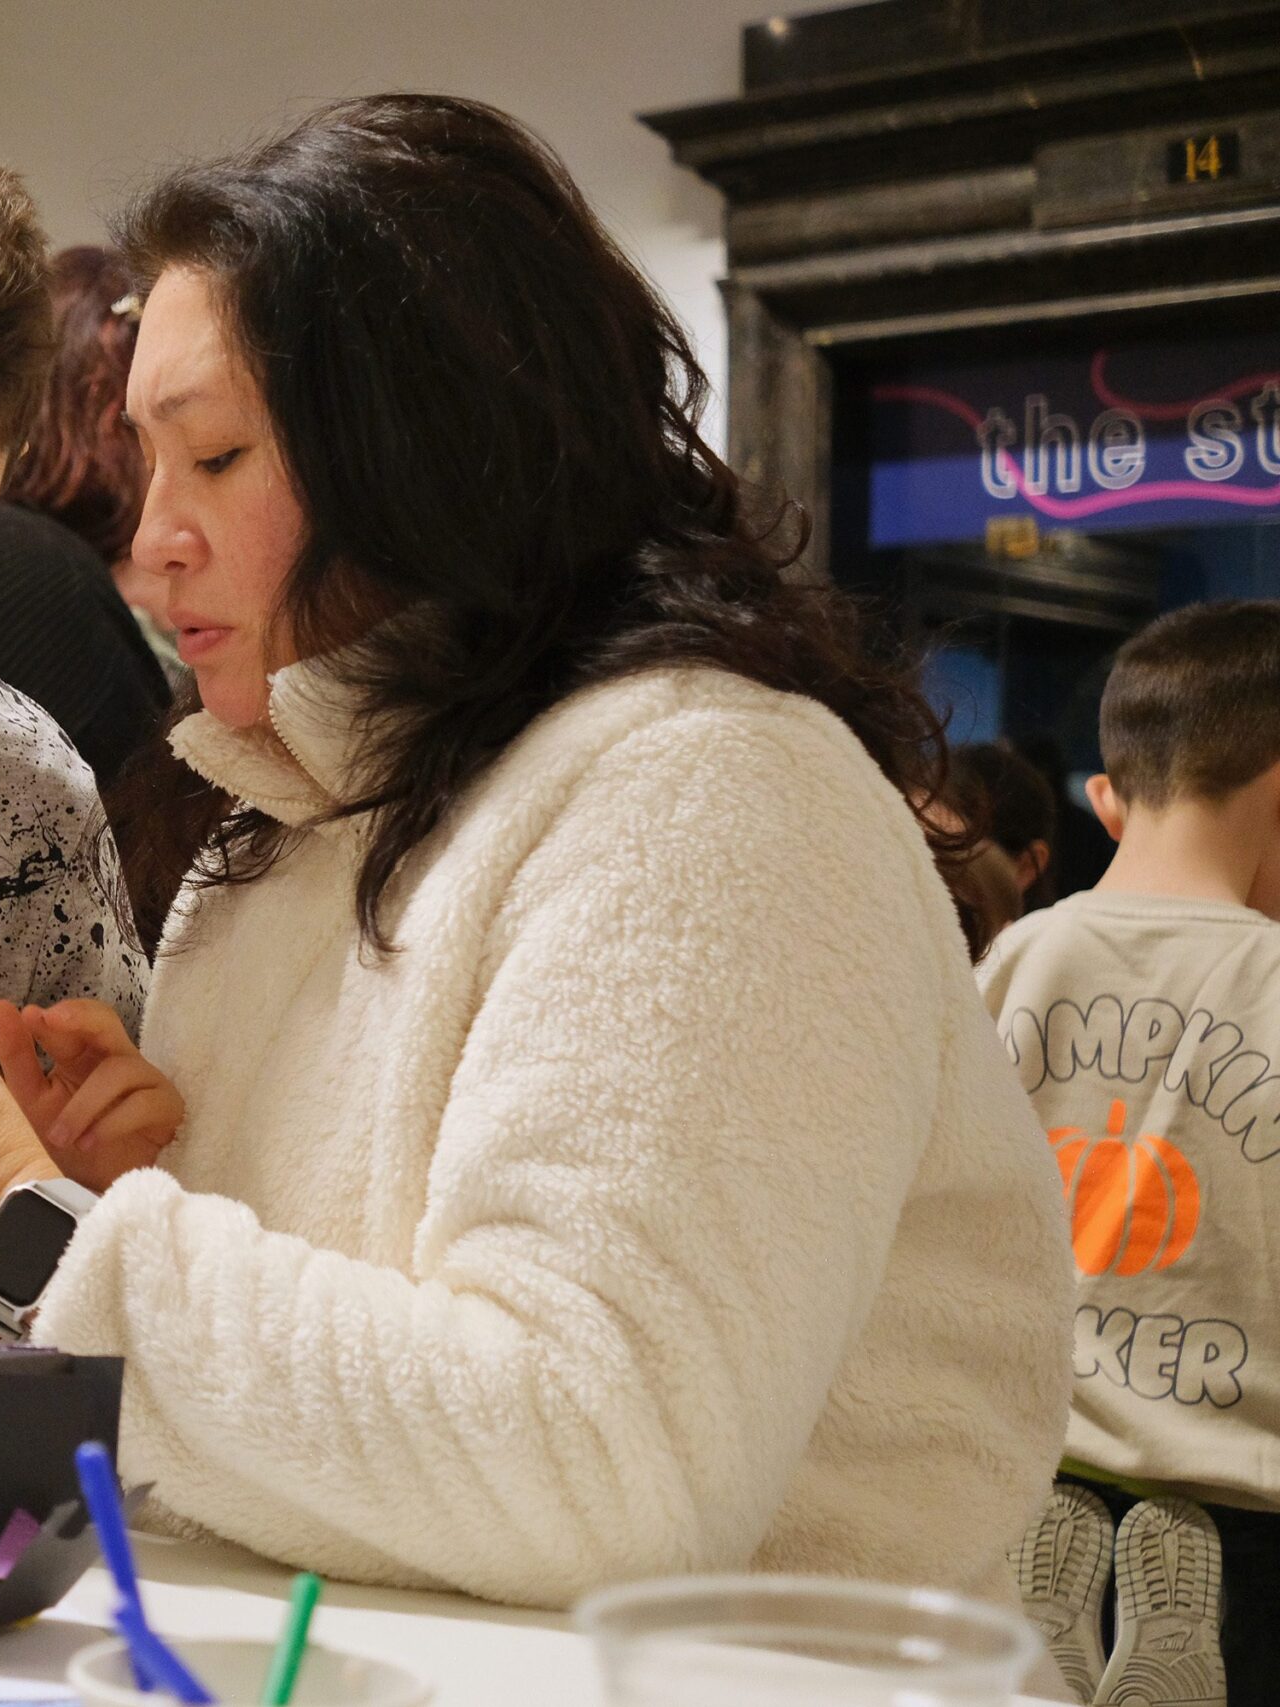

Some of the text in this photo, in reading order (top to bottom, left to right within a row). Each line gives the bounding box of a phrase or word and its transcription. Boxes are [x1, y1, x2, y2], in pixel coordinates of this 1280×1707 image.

[1185, 135, 1221, 182] 14
[976, 392, 1147, 500] the
[1073, 1304, 1249, 1410] KER
